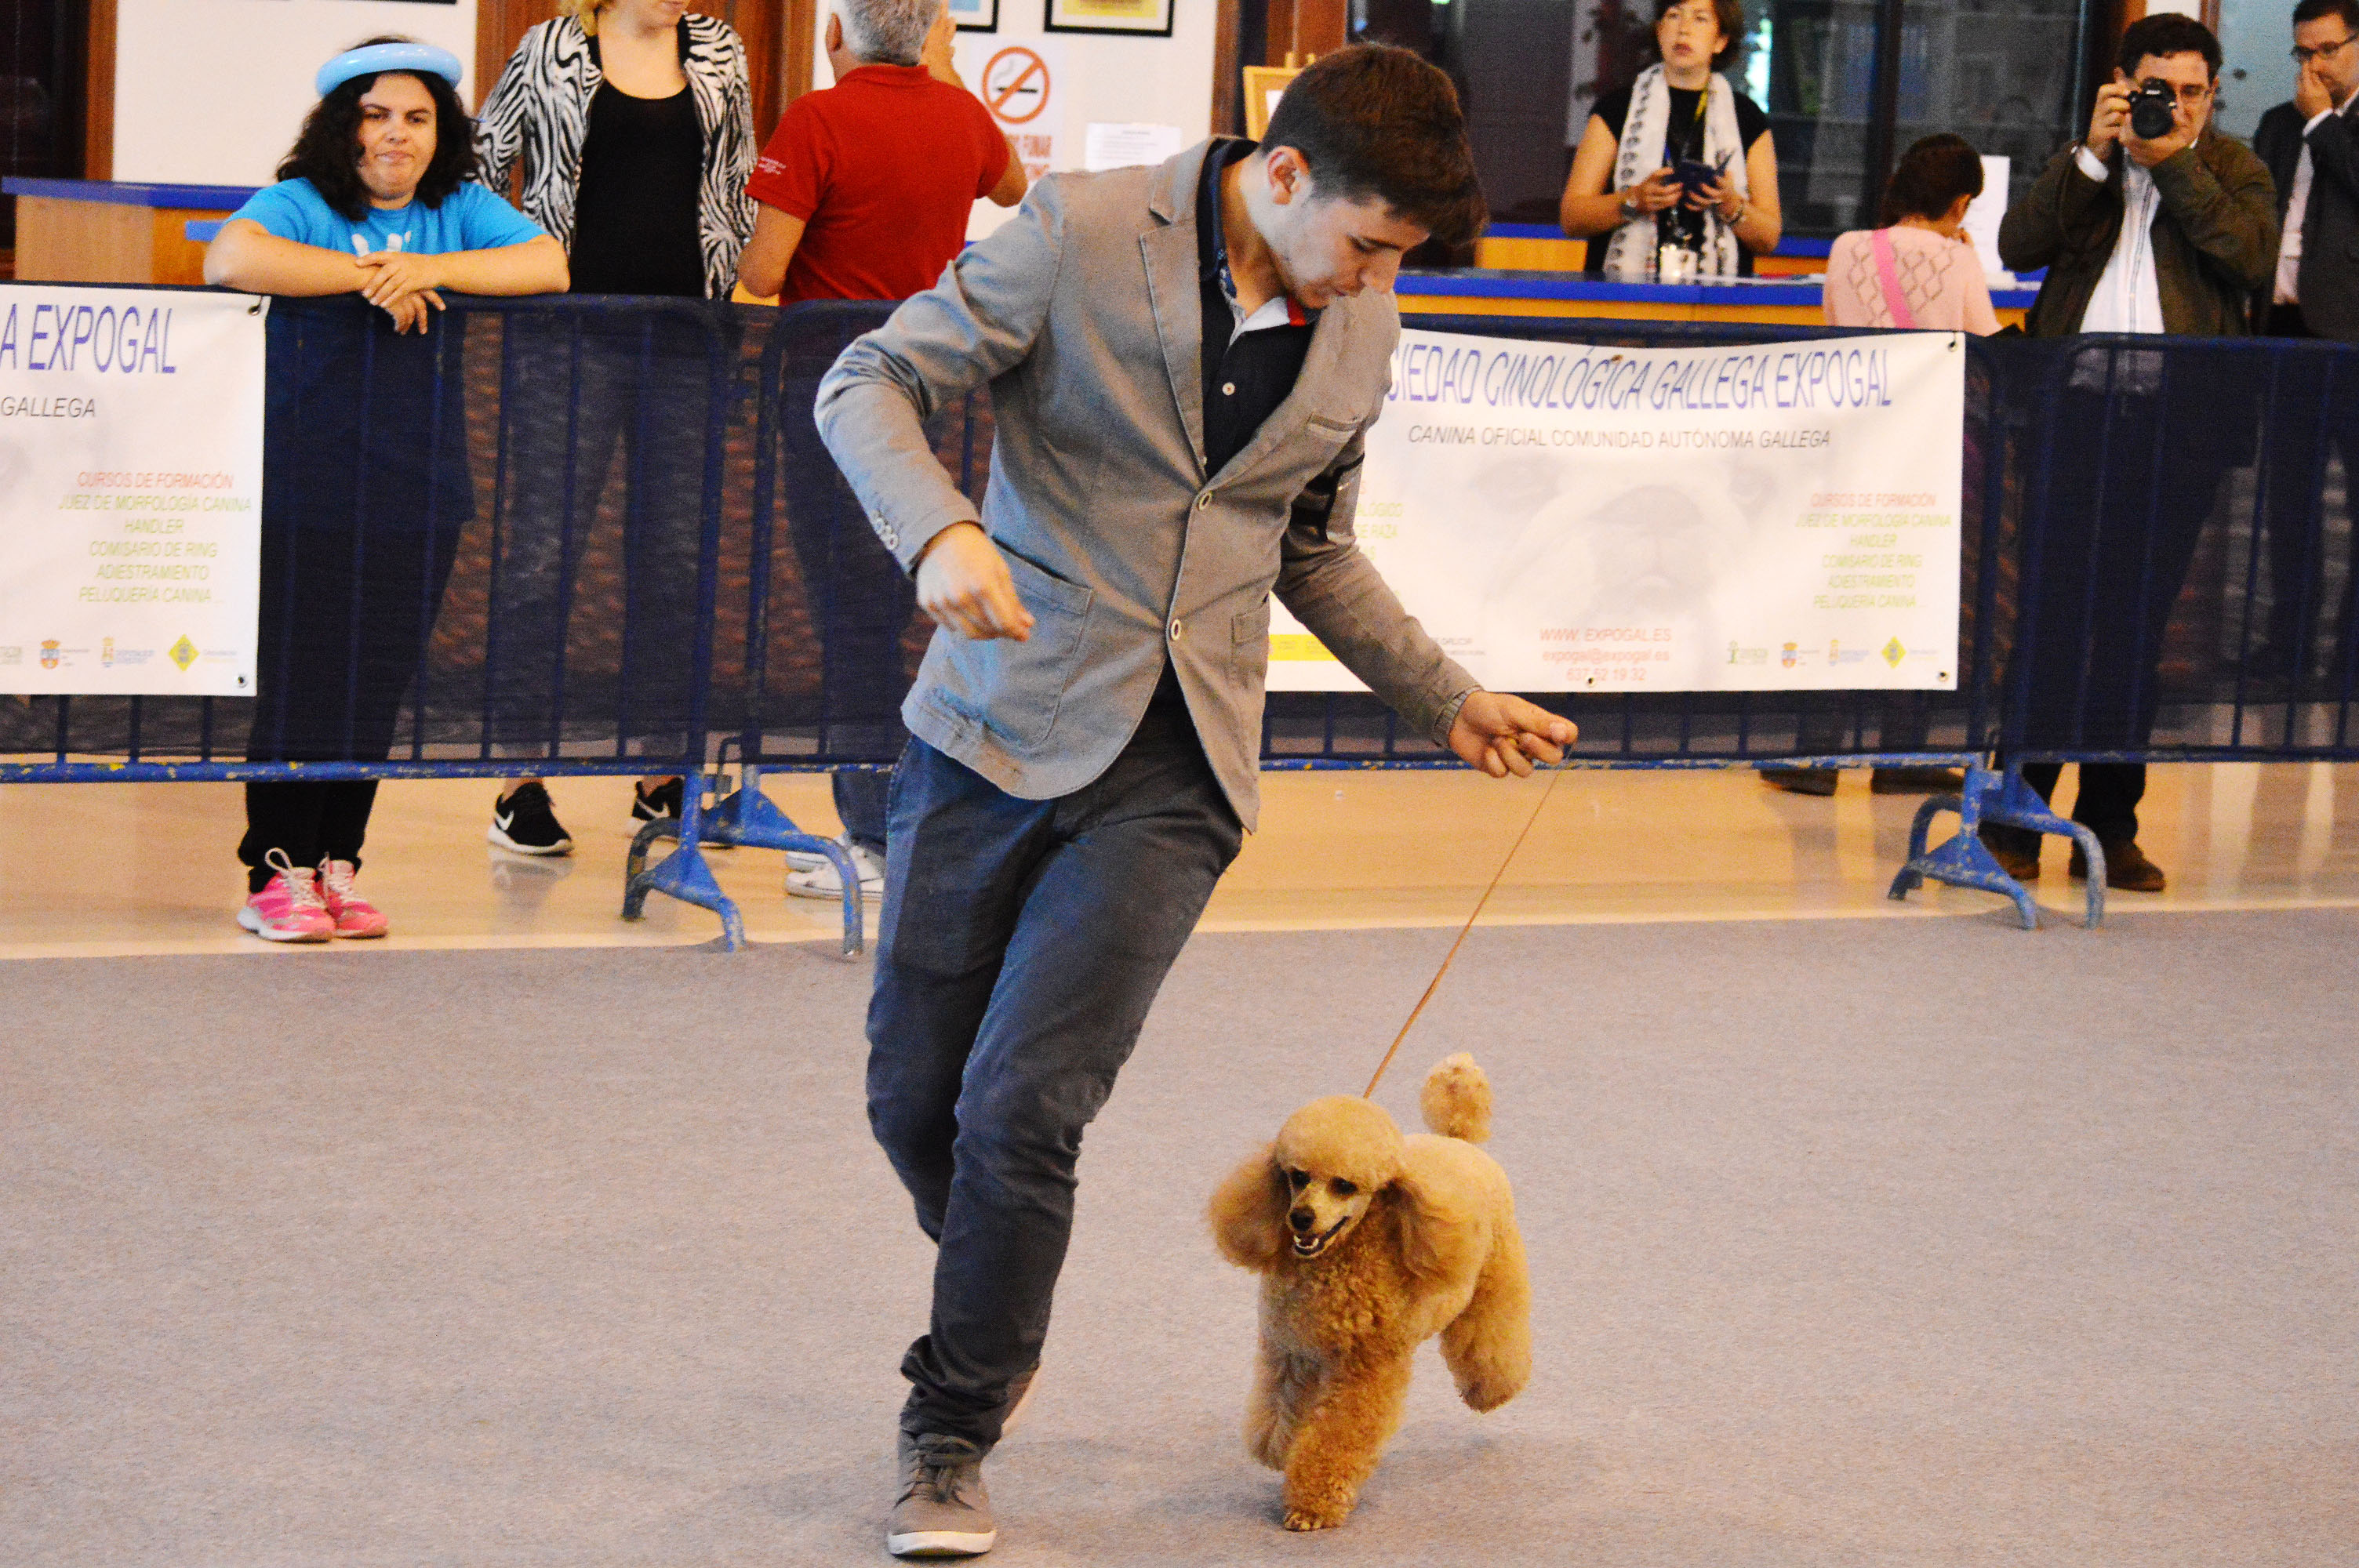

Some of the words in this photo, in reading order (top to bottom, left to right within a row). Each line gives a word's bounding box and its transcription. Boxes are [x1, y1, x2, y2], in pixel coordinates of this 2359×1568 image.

[28, 304, 176, 374] EXPOGAL
[1484, 345, 1652, 410] CINOLÓGICA
[1650, 354, 1771, 411] GALLEGA
[1775, 348, 1892, 408] EXPOGAL
[0, 396, 96, 418] GALLEGA
[1408, 424, 1476, 445] CANINA
[1481, 426, 1547, 447] OFICIAL
[1552, 429, 1654, 448] COMUNIDAD
[1658, 428, 1754, 448] AUTÓNOMA
[1760, 429, 1831, 448] GALLEGA
[77, 471, 132, 488] CURSOS
[135, 472, 155, 488] DE
[157, 470, 234, 489] FORMACIÓN
[58, 495, 92, 510] JUEZ
[93, 495, 112, 511] DE
[202, 495, 253, 513] CANINA
[1810, 493, 1856, 507] CURSOS
[1858, 493, 1873, 507] DE
[124, 517, 185, 534] HANDLER
[1823, 514, 1839, 528] DE
[1850, 533, 1899, 548] HANDLER
[89, 541, 162, 557] COMISARIO
[164, 542, 184, 558] DE
[185, 542, 219, 559] RING
[1881, 554, 1896, 568] DE
[96, 564, 210, 581] ADIESTRAMIENTO
[1828, 573, 1915, 589] ADIESTRAMIENTO
[162, 586, 213, 603] CANINA
[1612, 667, 1628, 681] 19
[1630, 667, 1648, 681] 32
